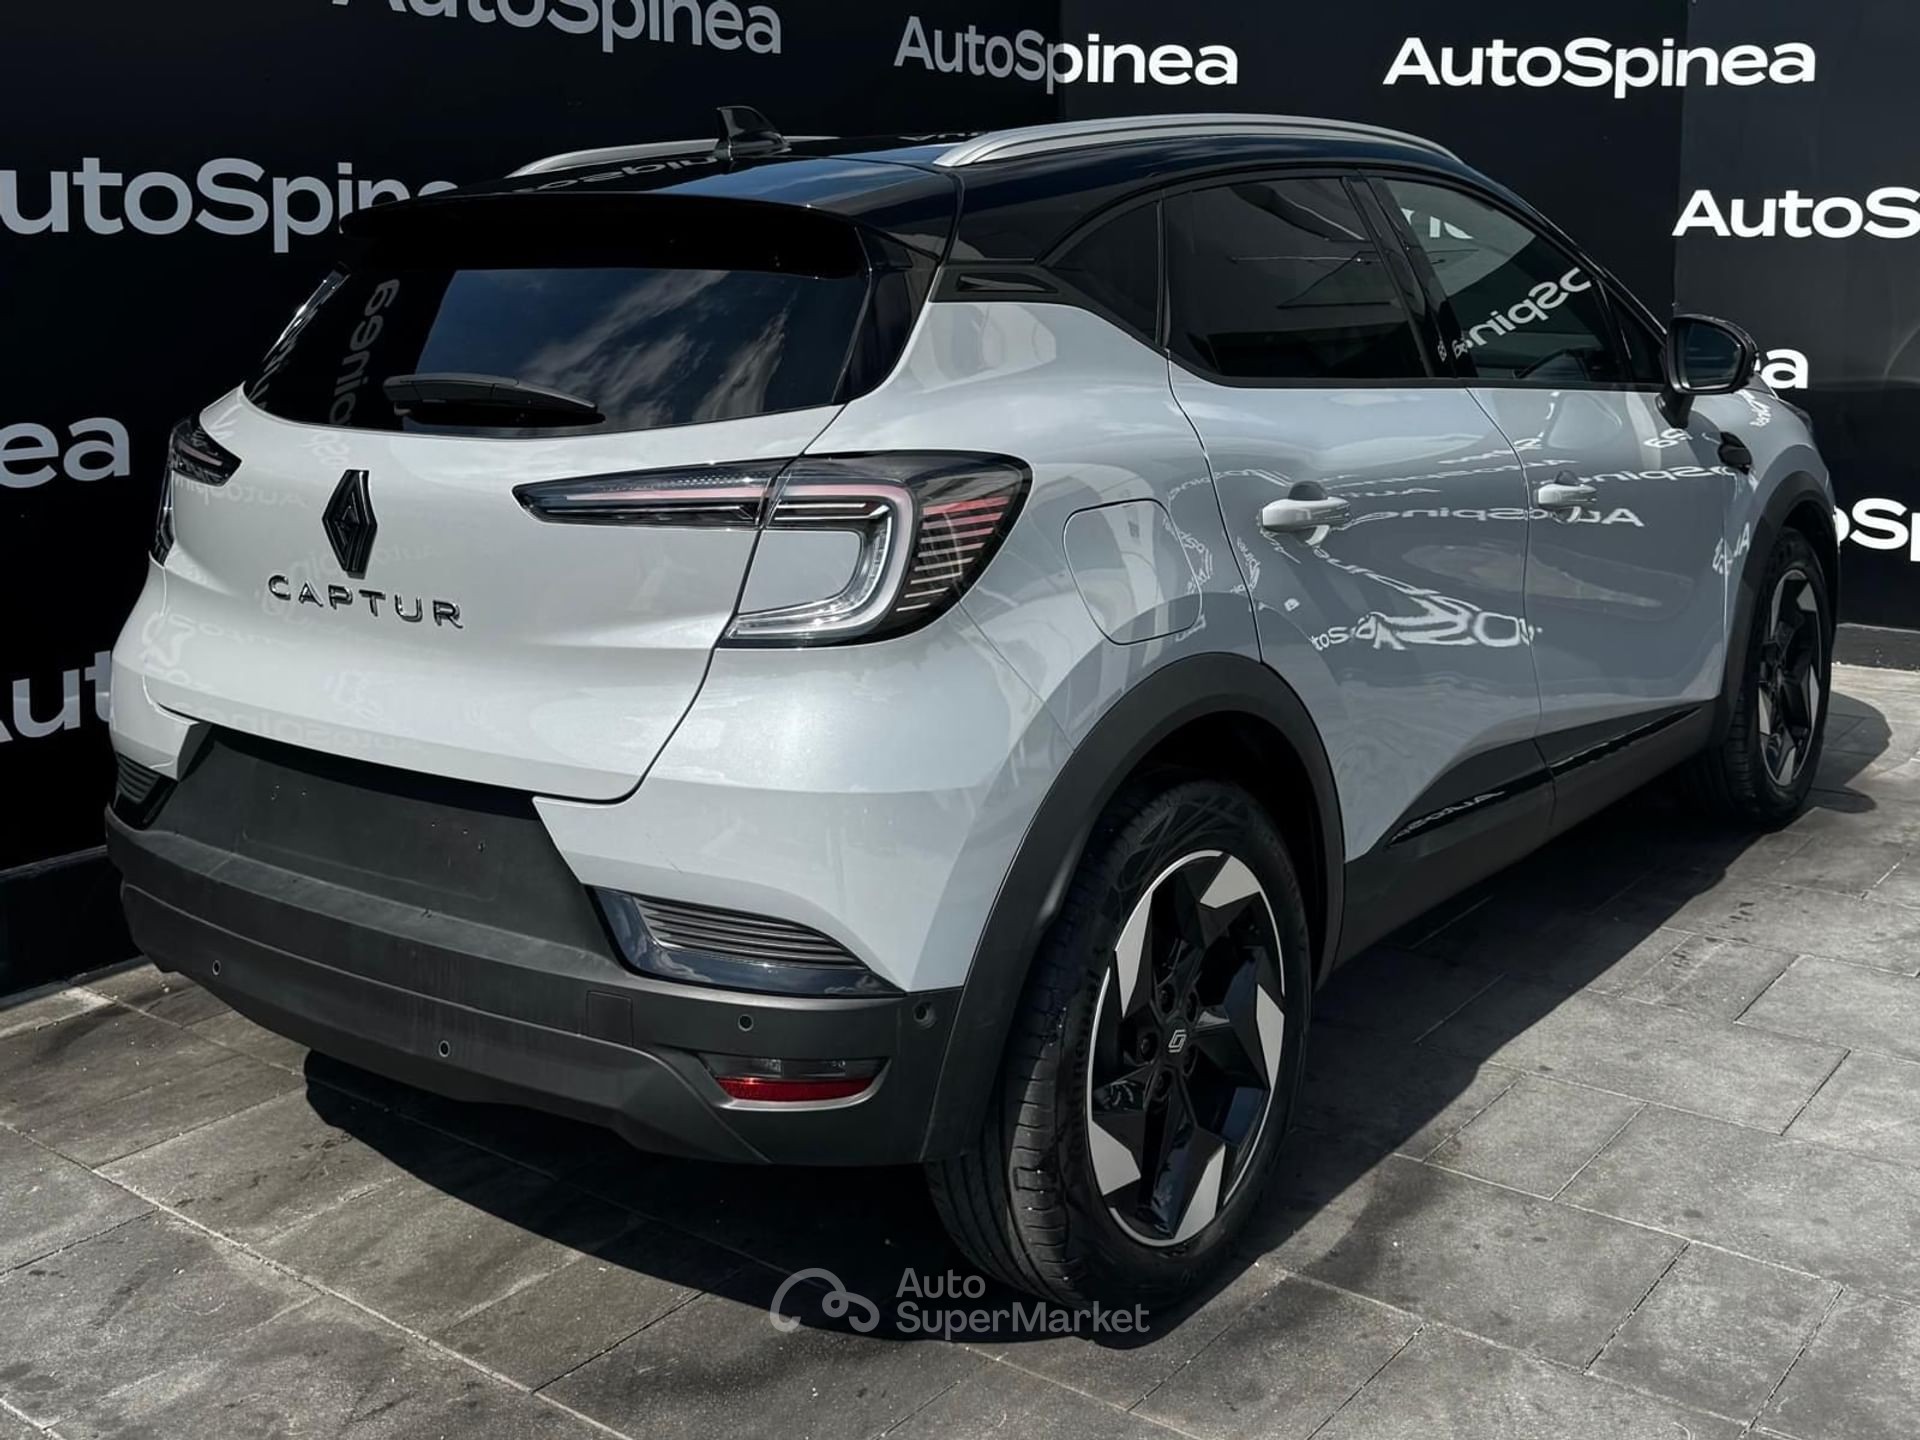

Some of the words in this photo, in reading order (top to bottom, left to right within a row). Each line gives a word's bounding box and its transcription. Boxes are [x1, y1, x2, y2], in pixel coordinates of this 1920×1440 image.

[894, 15, 1239, 94] AutoSpinea
[1382, 37, 1816, 99] AutoSpinea
[0, 416, 130, 488] ea
[268, 574, 464, 629] CAPTUR
